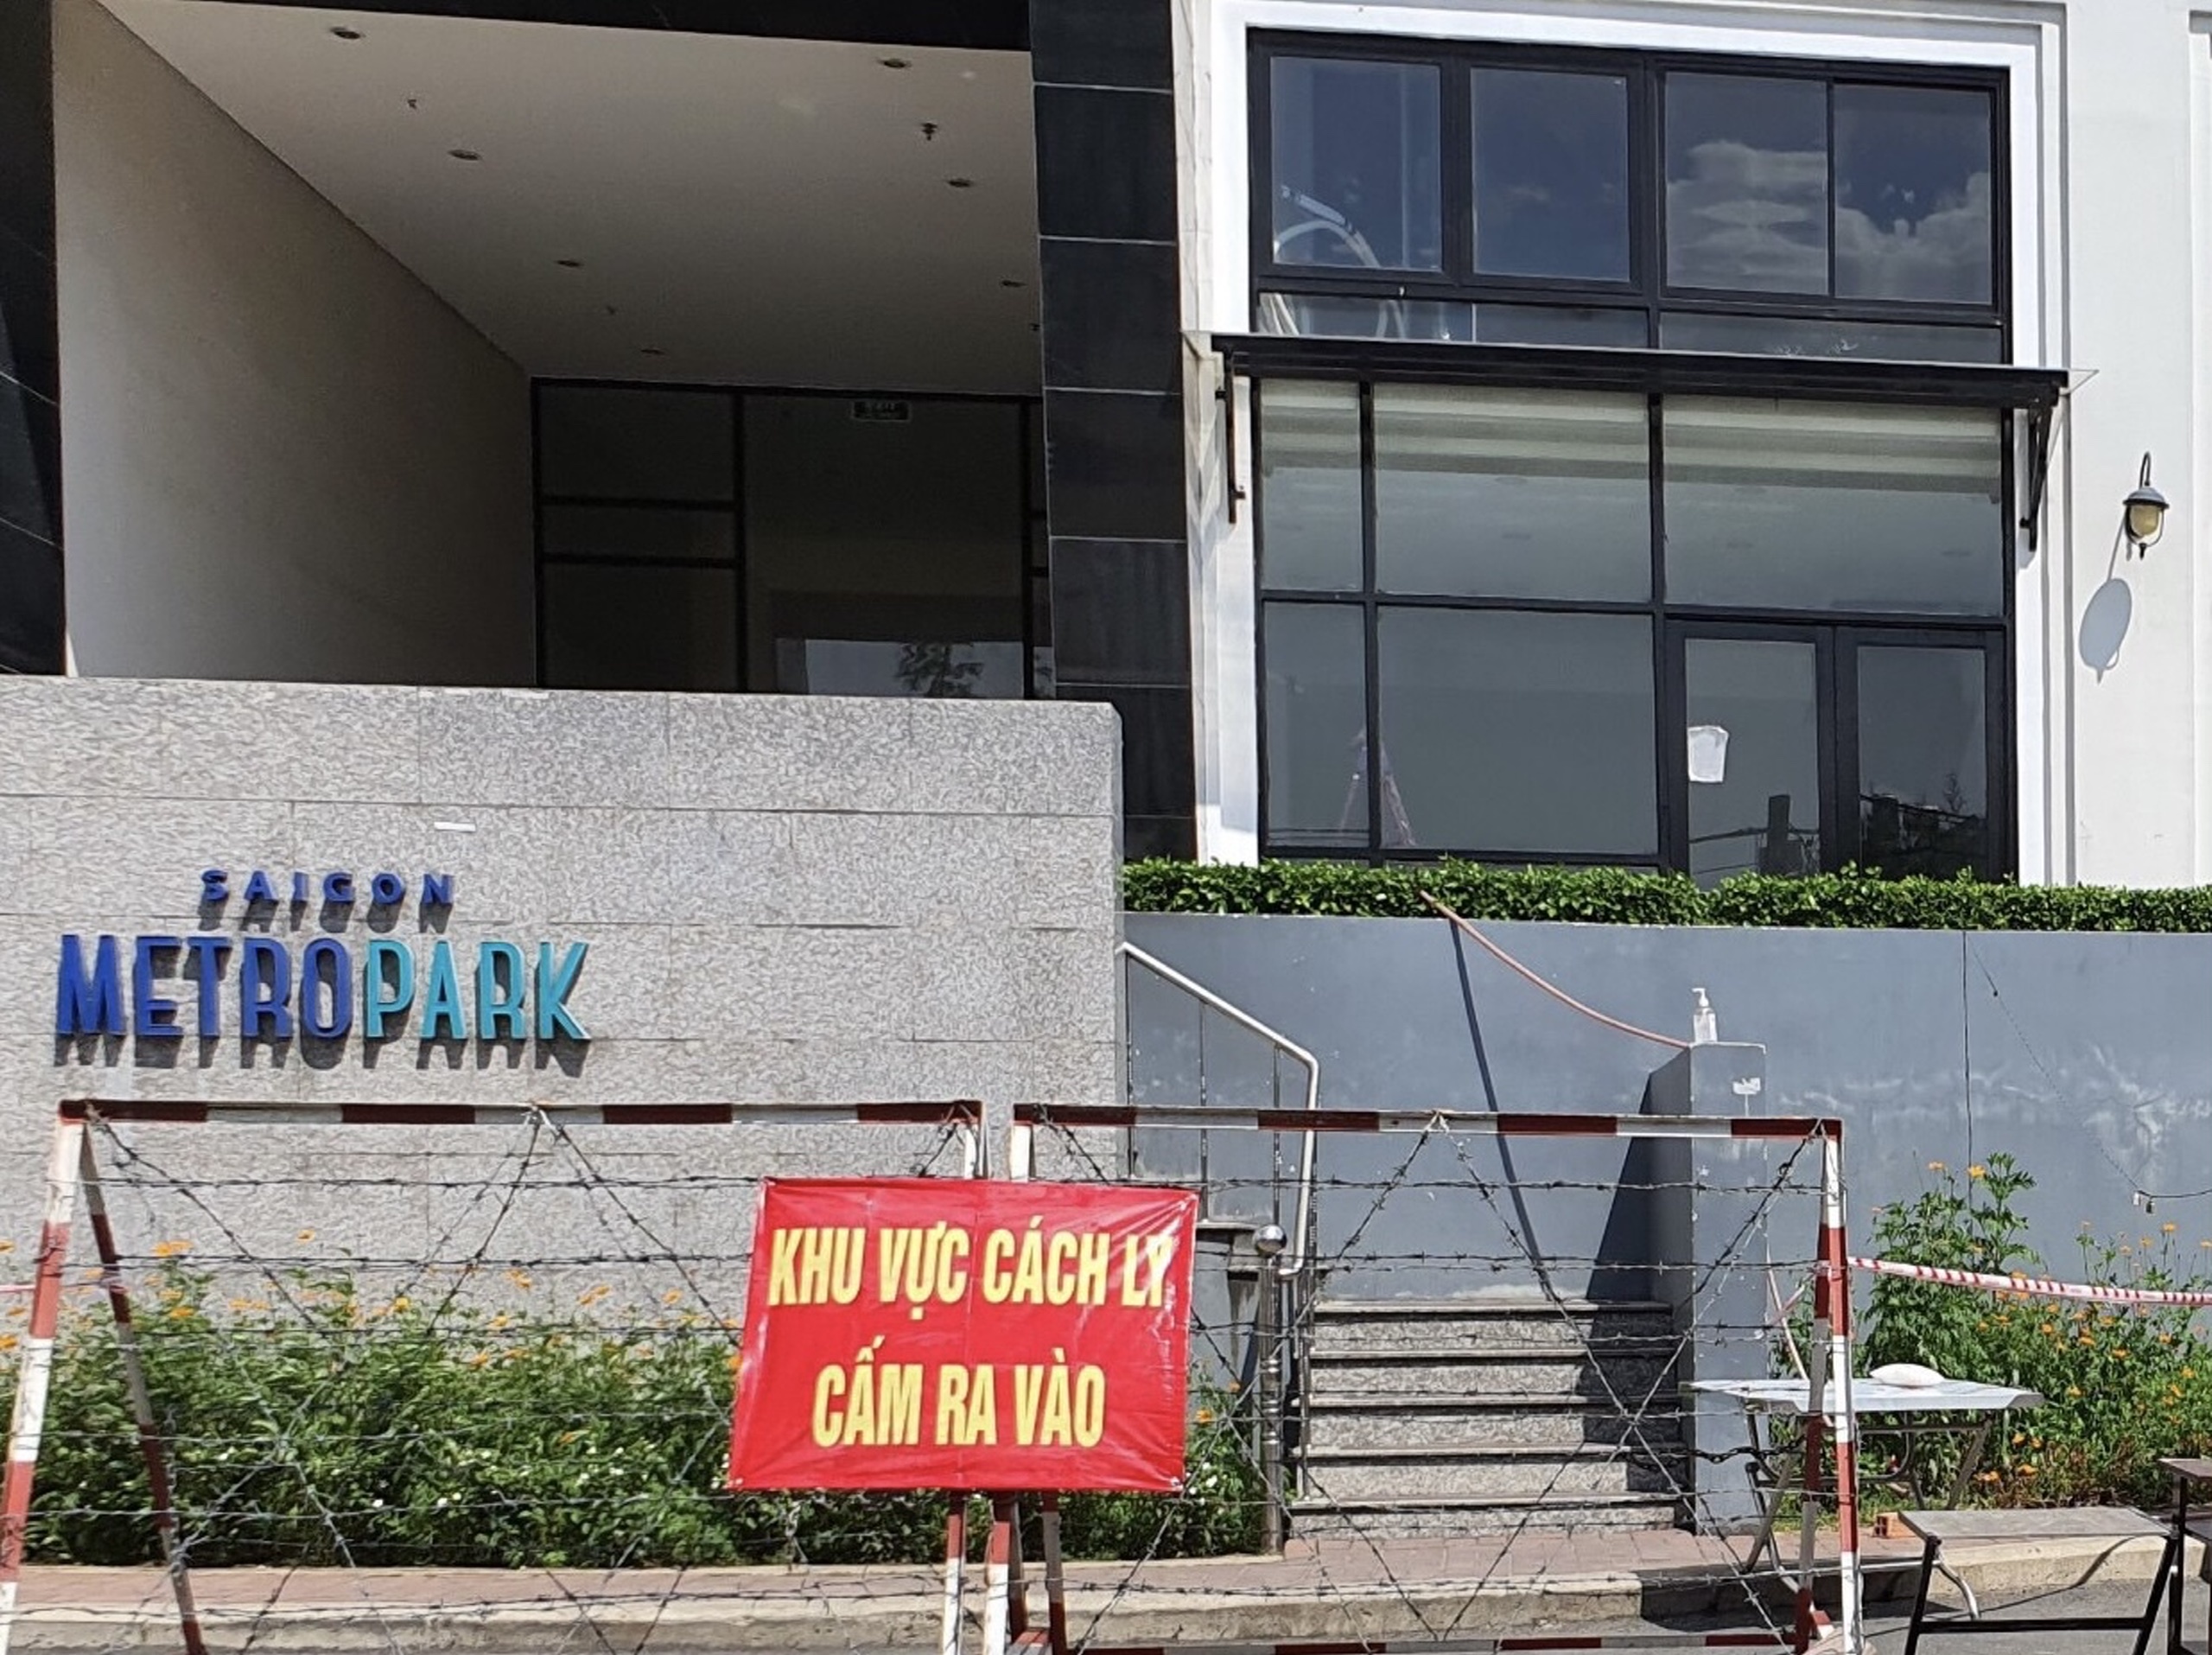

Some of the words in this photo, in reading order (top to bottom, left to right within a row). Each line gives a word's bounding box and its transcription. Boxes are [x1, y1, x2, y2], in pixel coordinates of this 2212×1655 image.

[200, 869, 453, 904] SAIGON
[56, 934, 590, 1040] METROPARK
[768, 1227, 865, 1305] KHU
[880, 1220, 969, 1320] VỰC
[982, 1215, 1109, 1305] CÁCH
[1122, 1234, 1173, 1307] LY
[811, 1335, 923, 1447] CẤM
[935, 1365, 997, 1445] RA
[1014, 1347, 1105, 1447] VÀO
